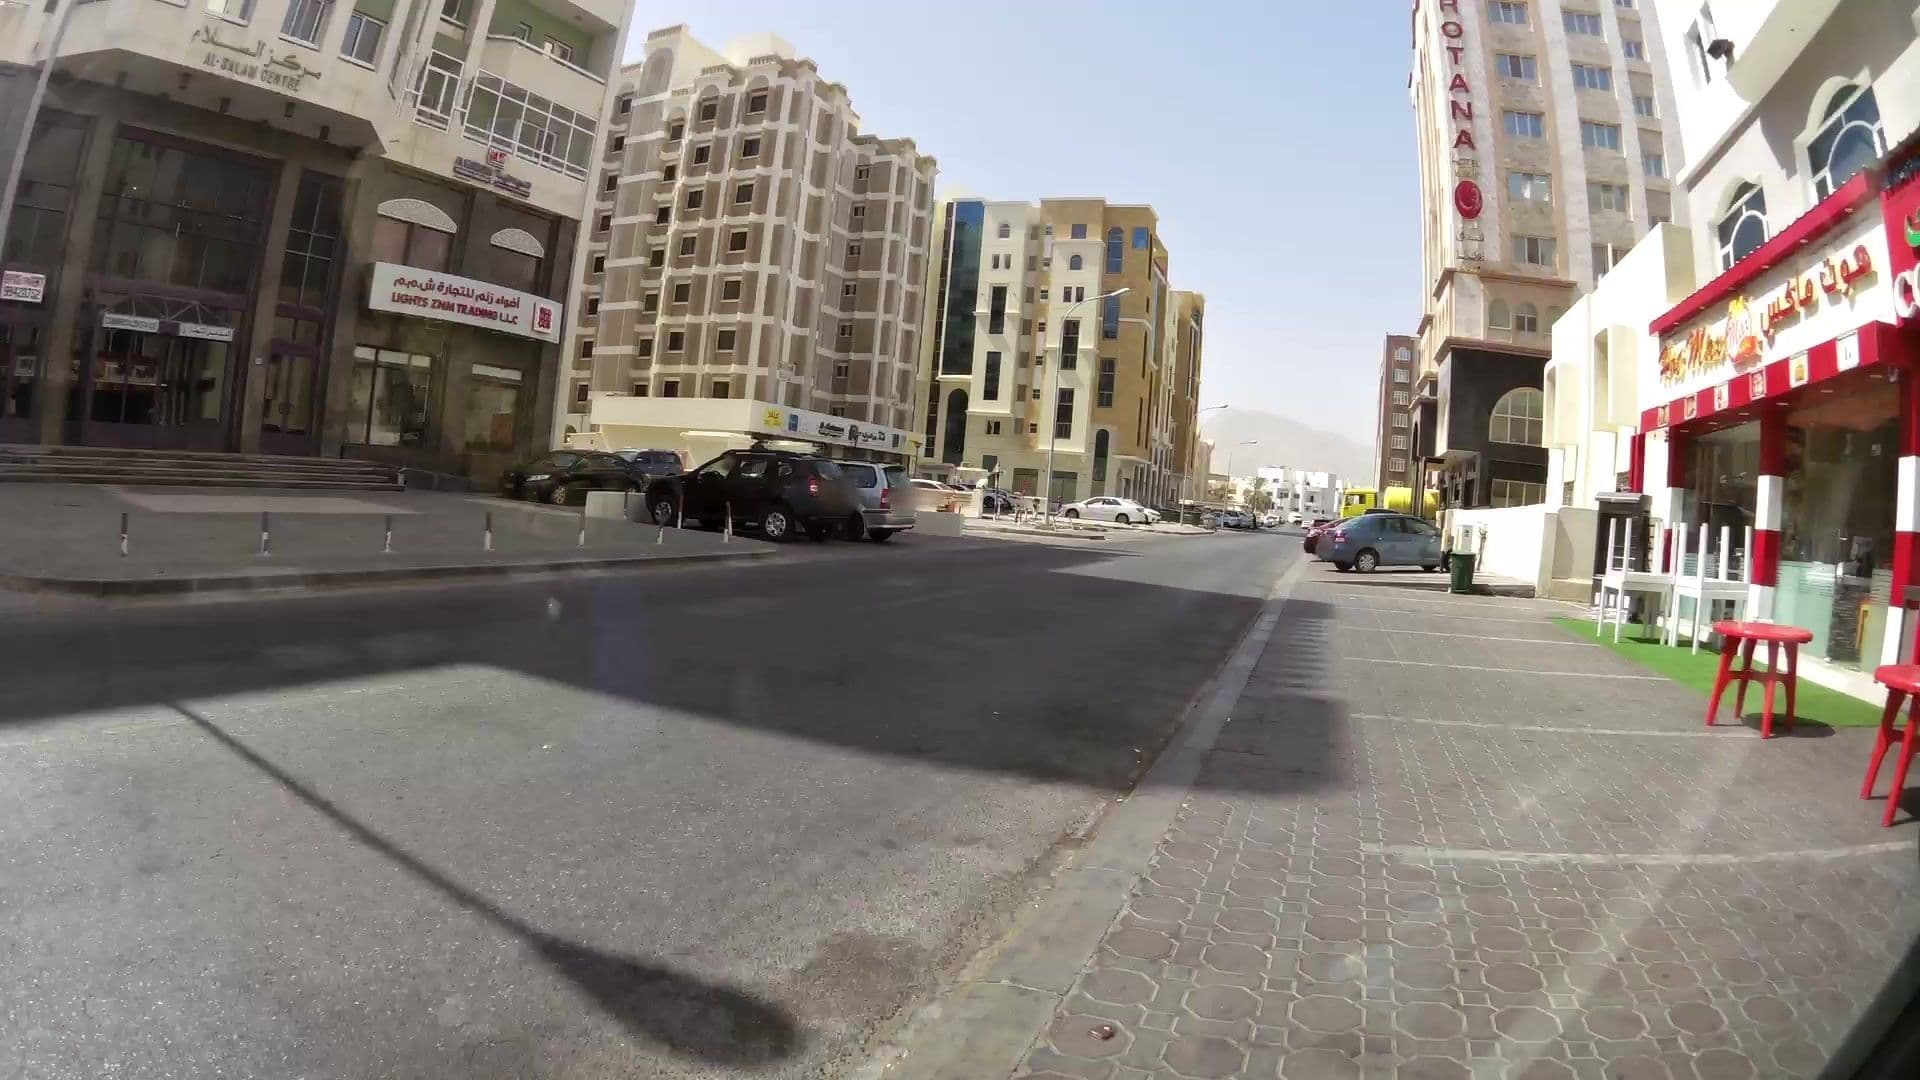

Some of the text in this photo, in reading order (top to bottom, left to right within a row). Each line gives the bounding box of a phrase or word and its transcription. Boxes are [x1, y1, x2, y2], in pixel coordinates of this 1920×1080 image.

[190, 25, 321, 79] مركز السلام
[261, 69, 301, 92] CENTRE
[1440, 0, 1476, 151] ROTANA
[391, 292, 429, 308] LIGHTS
[456, 303, 498, 321] TRADING
[437, 281, 475, 299] للتجارة
[1760, 244, 1873, 338] هوت ماكس
